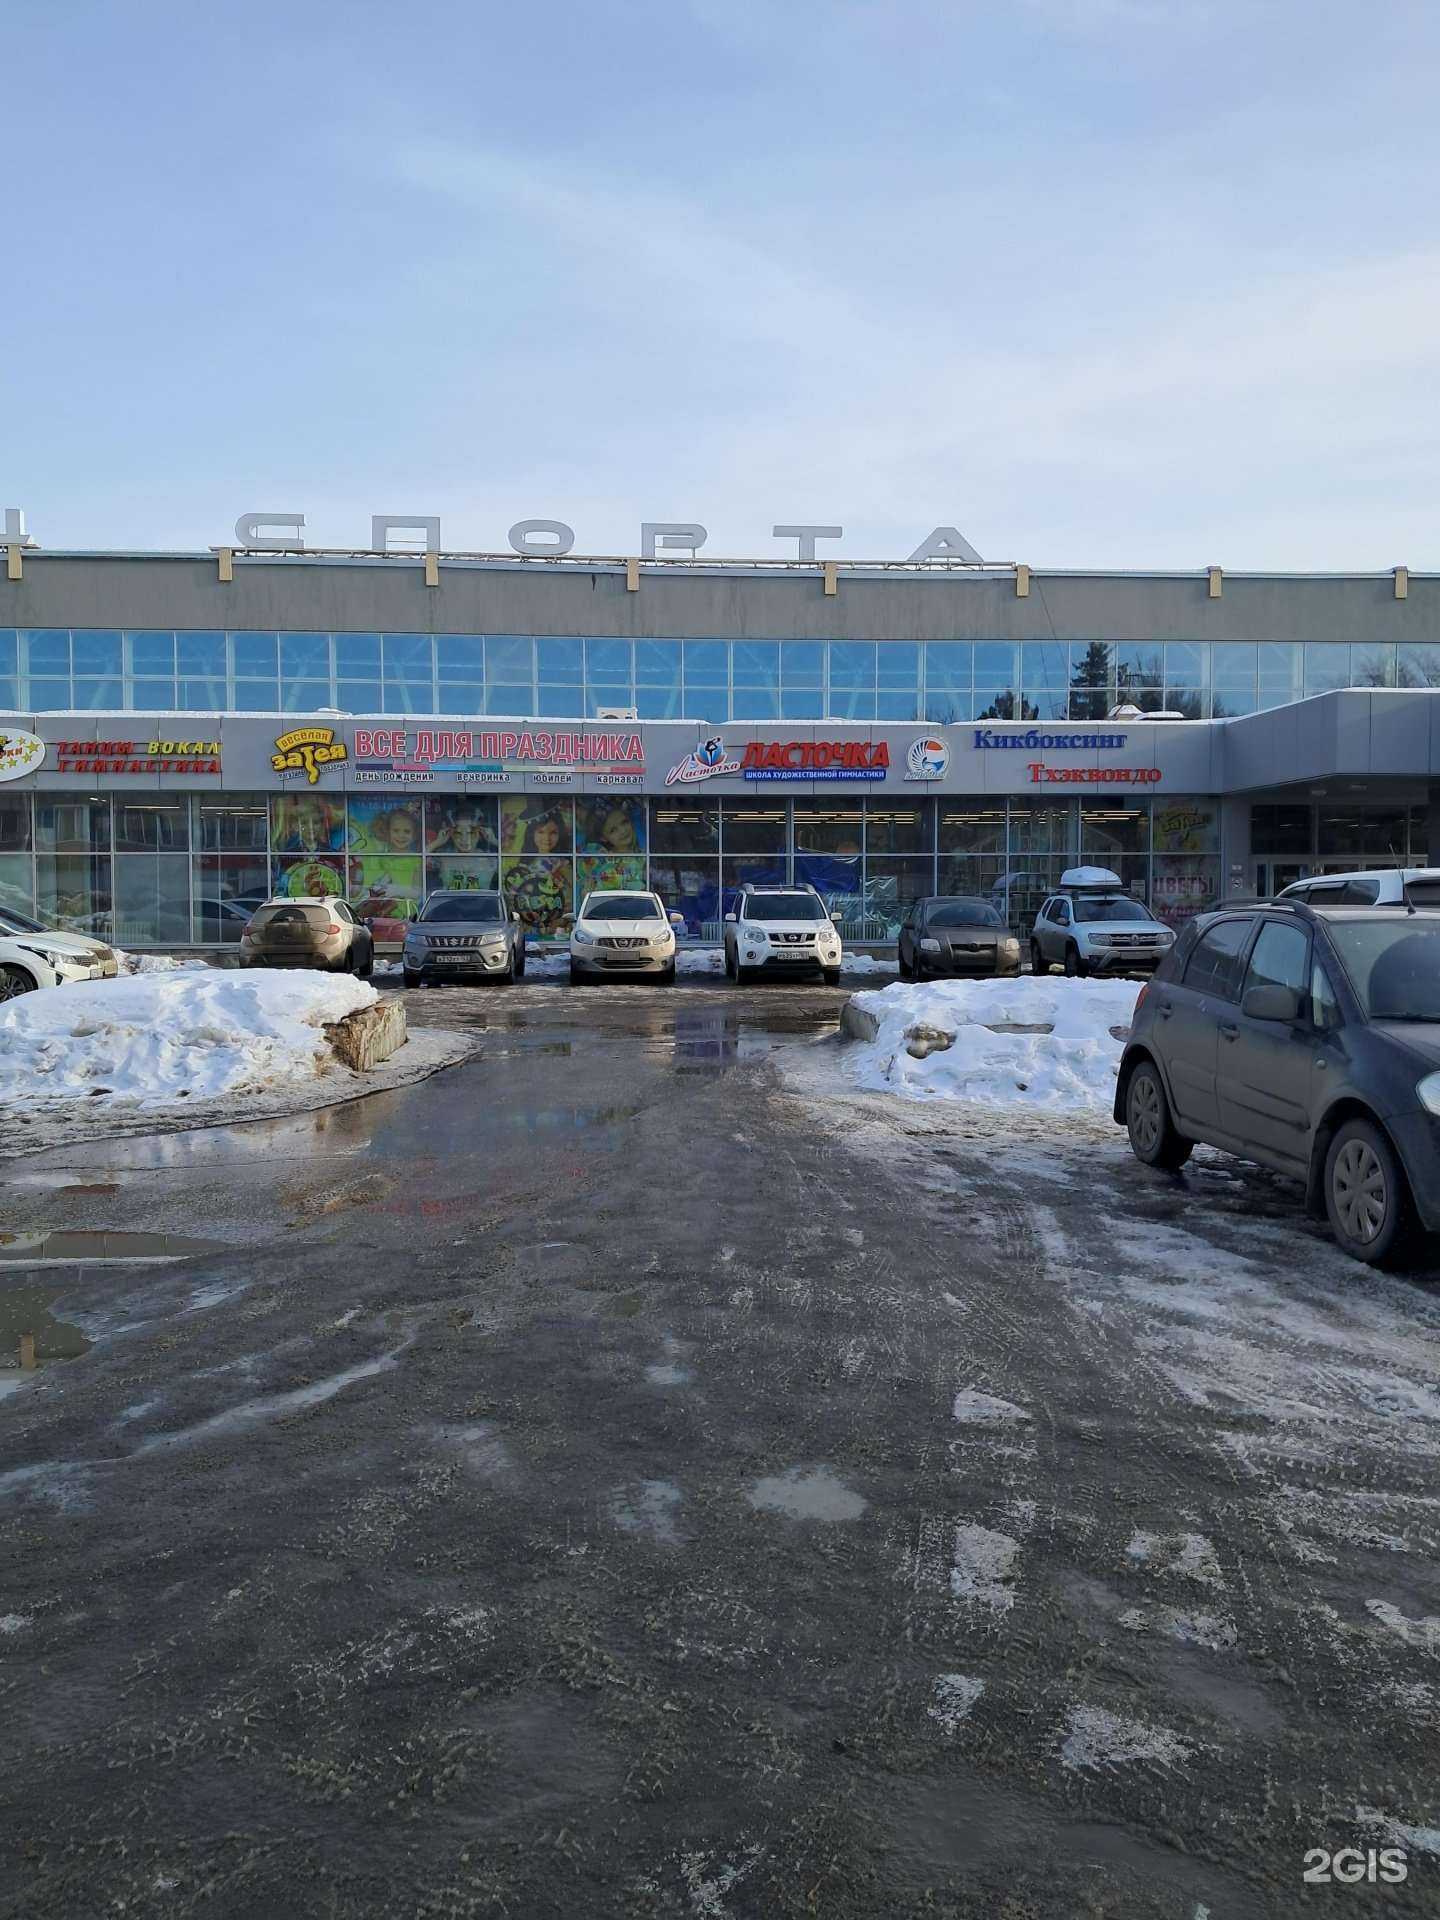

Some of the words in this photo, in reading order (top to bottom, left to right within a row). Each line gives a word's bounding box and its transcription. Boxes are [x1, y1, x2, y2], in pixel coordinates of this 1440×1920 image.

[355, 730, 406, 757] ВСЕ
[414, 731, 473, 762] ДЛЯ
[481, 732, 645, 764] ПРАЗДНИКА
[974, 730, 1128, 749] Кикбоксинг
[57, 740, 134, 756] ТАНЦЫ
[147, 741, 220, 755] ВОКАЛ
[741, 742, 889, 769] ЛАСТОЧКА
[58, 759, 221, 773] ГИМНАСТИКА
[666, 754, 740, 785] Ласточка
[355, 773, 381, 782] день
[383, 773, 434, 783] рождения
[457, 773, 510, 782] вечеринка
[533, 773, 572, 783] юбилей
[597, 775, 645, 784] карнавал
[746, 770, 772, 779] ШКОЛА
[773, 770, 837, 780] ХУДОЖЕСТВЕННОЙ
[838, 770, 885, 779] ГИМНАСТИКИ
[1028, 763, 1162, 785] Тхэквондо
